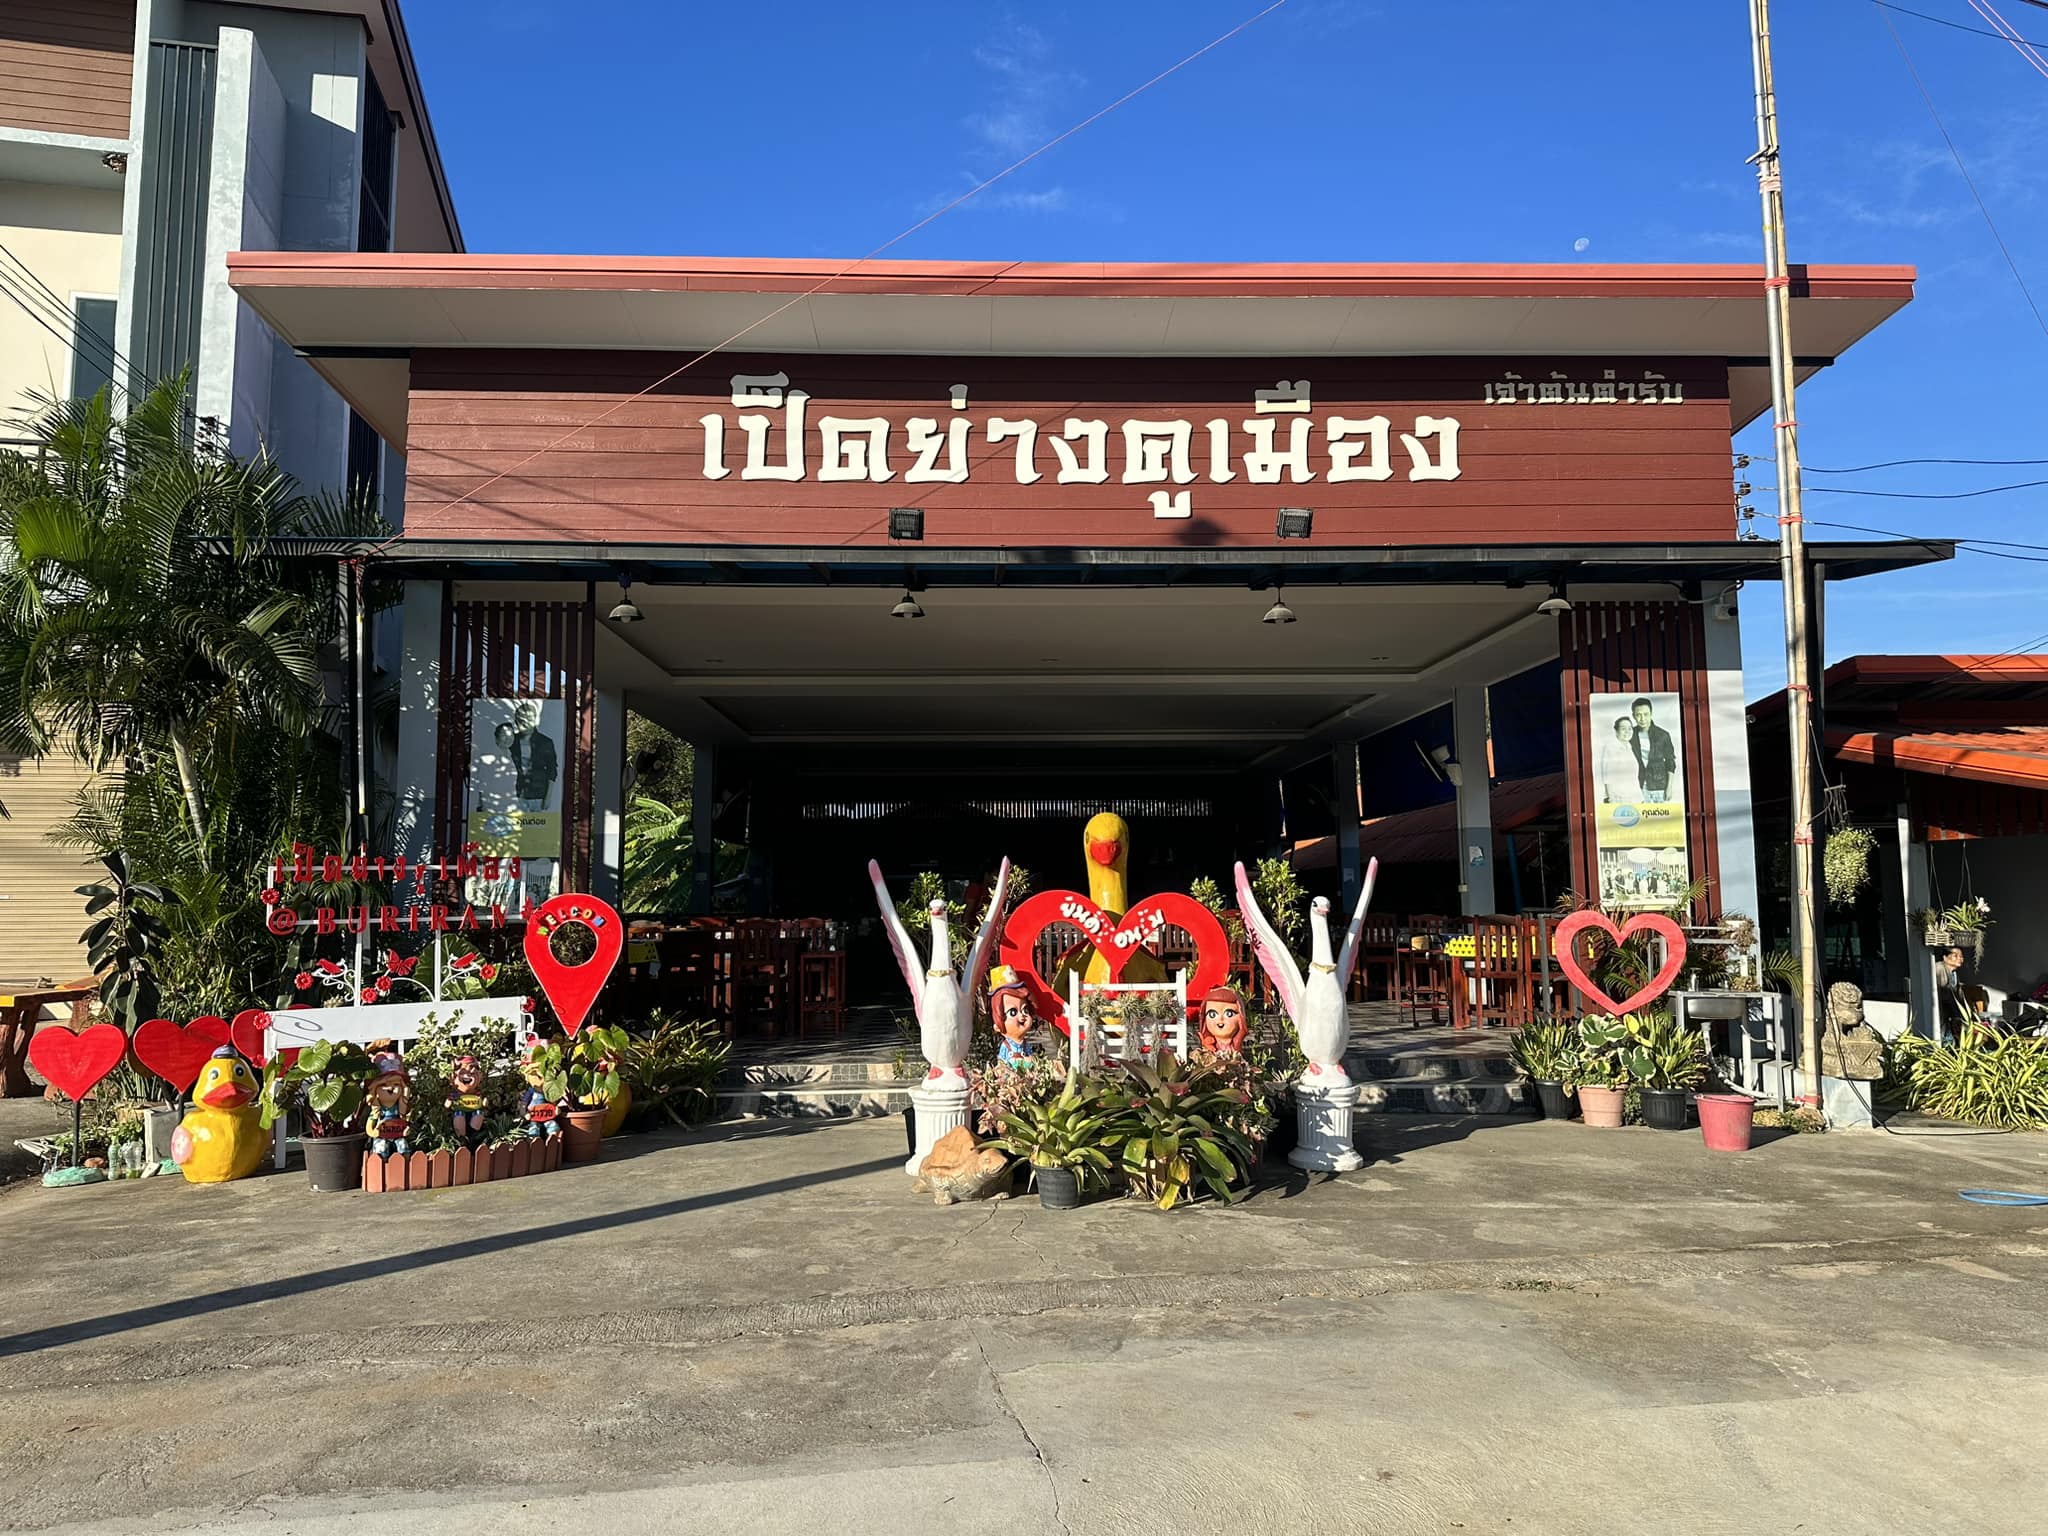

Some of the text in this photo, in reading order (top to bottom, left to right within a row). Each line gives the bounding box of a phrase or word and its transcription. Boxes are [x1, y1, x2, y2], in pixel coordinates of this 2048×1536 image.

[698, 370, 1463, 519] เป็ดย่างคูเมือง
